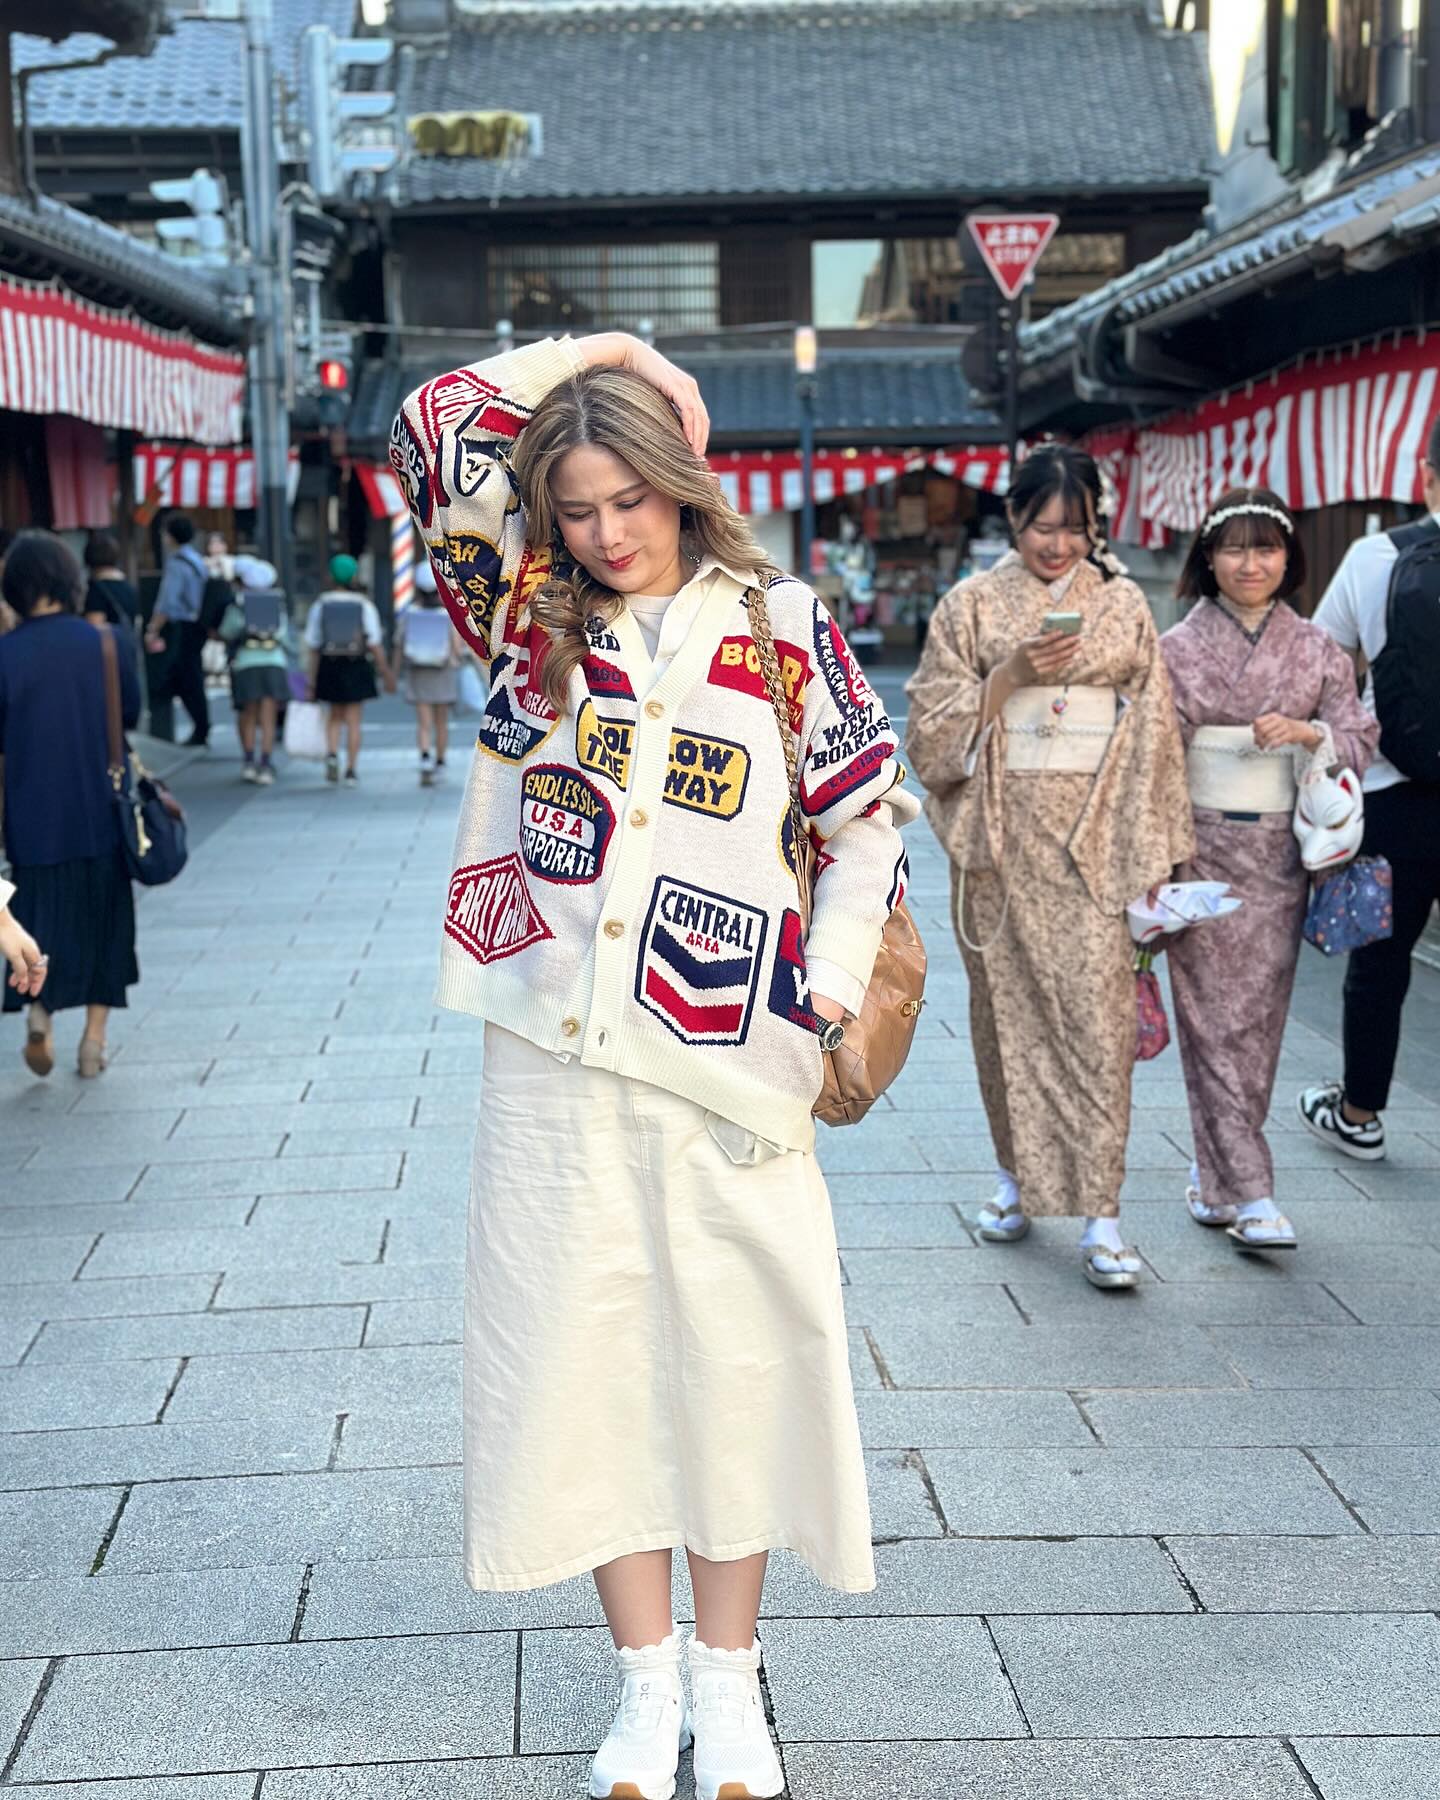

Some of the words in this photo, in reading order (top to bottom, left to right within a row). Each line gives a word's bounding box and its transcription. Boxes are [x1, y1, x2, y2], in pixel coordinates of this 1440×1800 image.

[810, 715, 890, 772] BOARDS
[823, 702, 874, 746] WEST
[525, 773, 602, 819] ENDLESSLY
[664, 768, 732, 807] WAY
[531, 803, 583, 839] U.S.A
[522, 825, 596, 876] ORPORATE
[661, 890, 753, 953] CENTRAL
[686, 931, 720, 955] AREA
